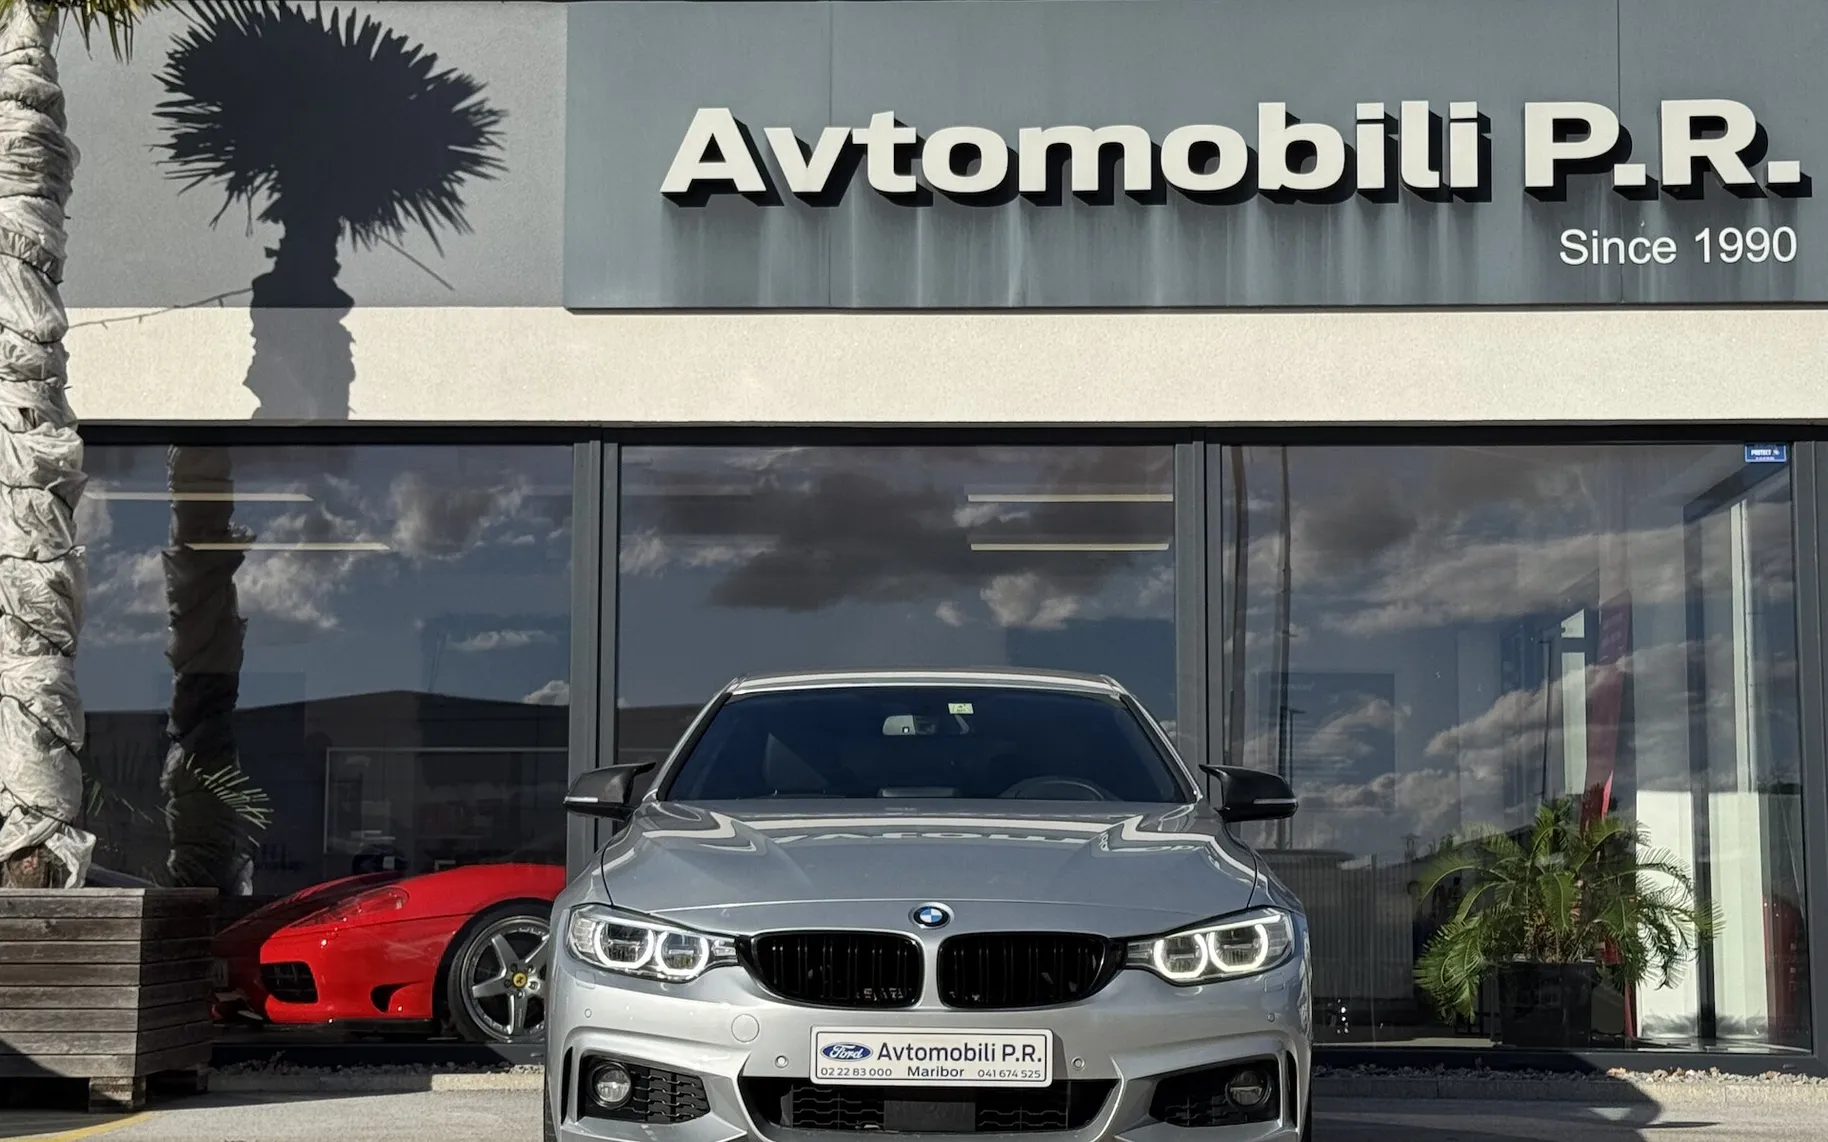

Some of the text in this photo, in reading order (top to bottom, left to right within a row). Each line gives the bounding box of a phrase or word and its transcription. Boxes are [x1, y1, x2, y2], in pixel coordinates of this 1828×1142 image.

[660, 99, 1801, 193] Avtomobili P.R.
[1559, 226, 1797, 265] Since 1990
[829, 1044, 864, 1058] Ford
[877, 1042, 1042, 1063] Avtomobili P.R.
[820, 1067, 893, 1077] 02 22 83 000
[907, 1065, 965, 1078] Maribor
[977, 1069, 1041, 1079] 041 674 525
